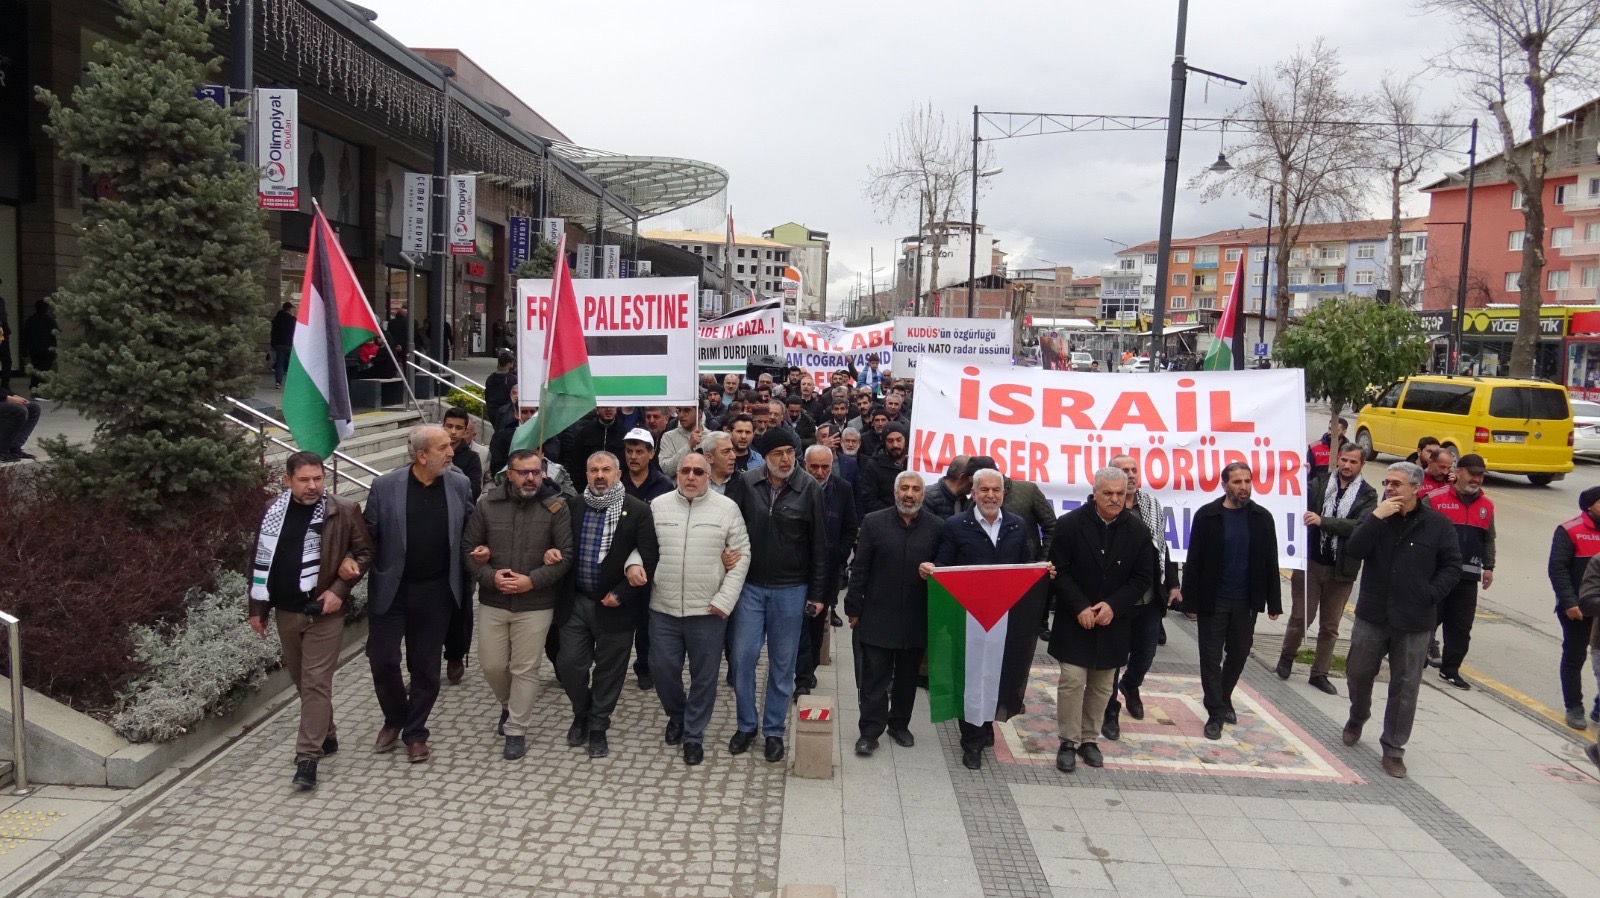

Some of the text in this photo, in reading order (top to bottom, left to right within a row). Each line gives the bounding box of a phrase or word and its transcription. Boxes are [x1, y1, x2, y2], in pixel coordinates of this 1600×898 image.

[269, 95, 284, 161] Olimpiyat
[457, 179, 467, 223] Olimpiyat
[584, 293, 689, 331] PALESTINE
[698, 326, 720, 339] IDE
[722, 324, 734, 339] IN
[850, 326, 894, 350] ABD
[907, 325, 996, 342] KUDÜS'ün özgürlüğü
[892, 341, 1010, 355] Kürecik NATO radar üssünü
[958, 366, 1255, 433] İSRAİL
[1437, 502, 1460, 510] POLİS
